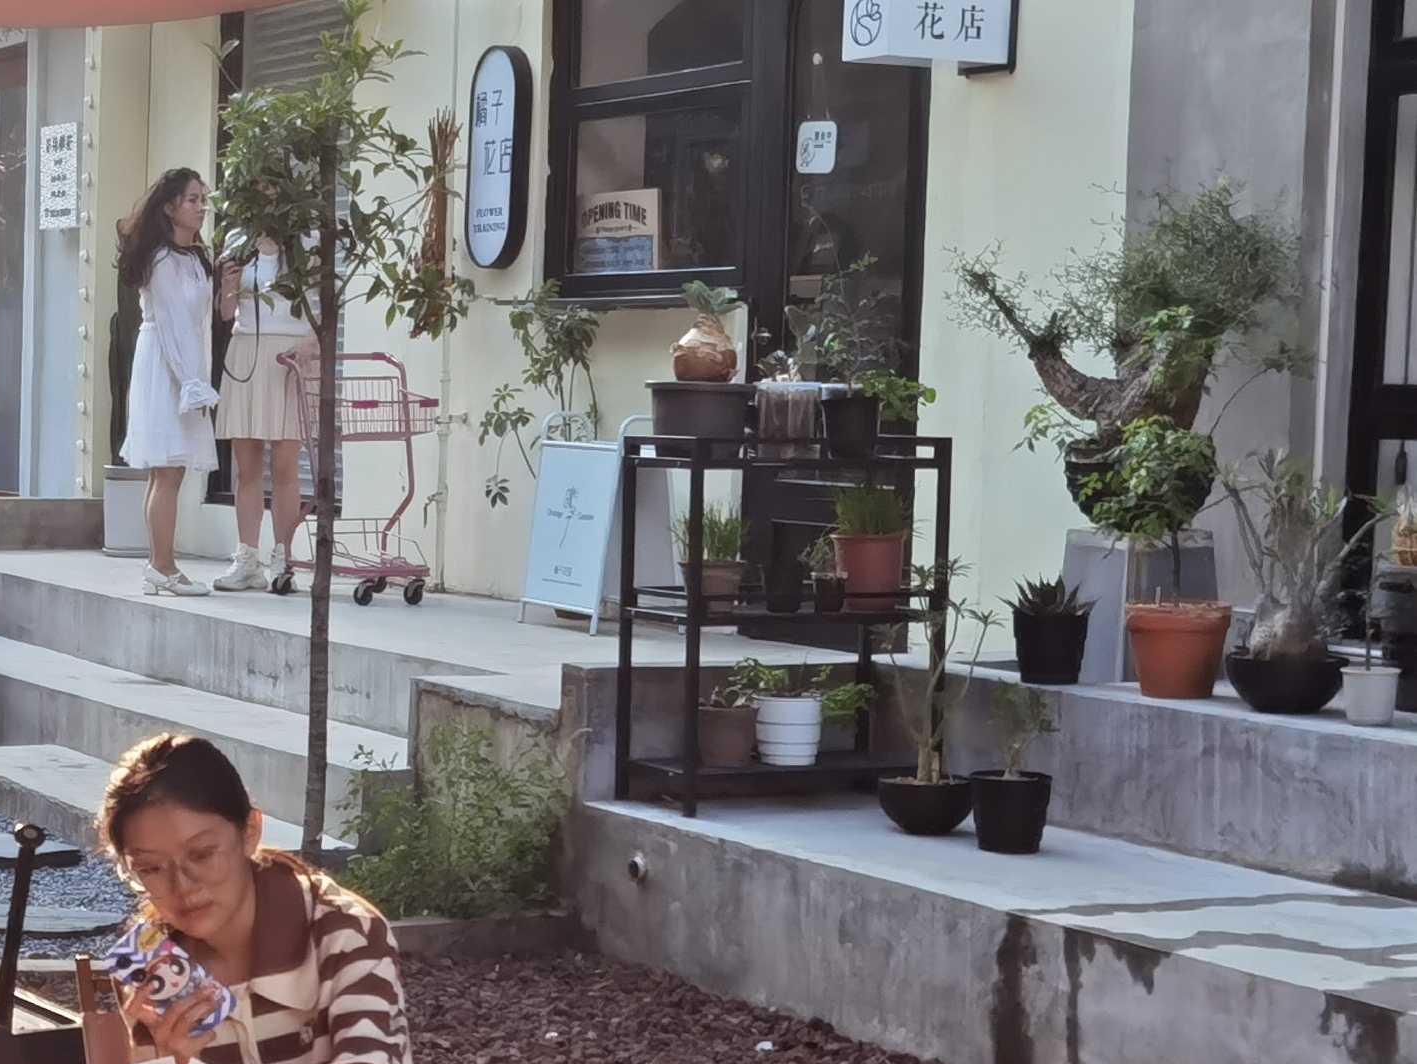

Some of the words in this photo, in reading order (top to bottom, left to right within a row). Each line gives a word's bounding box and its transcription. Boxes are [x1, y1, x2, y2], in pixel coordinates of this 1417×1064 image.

[914, 2, 985, 42] 花店
[483, 137, 513, 176] 花店
[476, 207, 503, 219] FLOWER
[581, 201, 622, 229] OPENING
[623, 201, 647, 227] TIME
